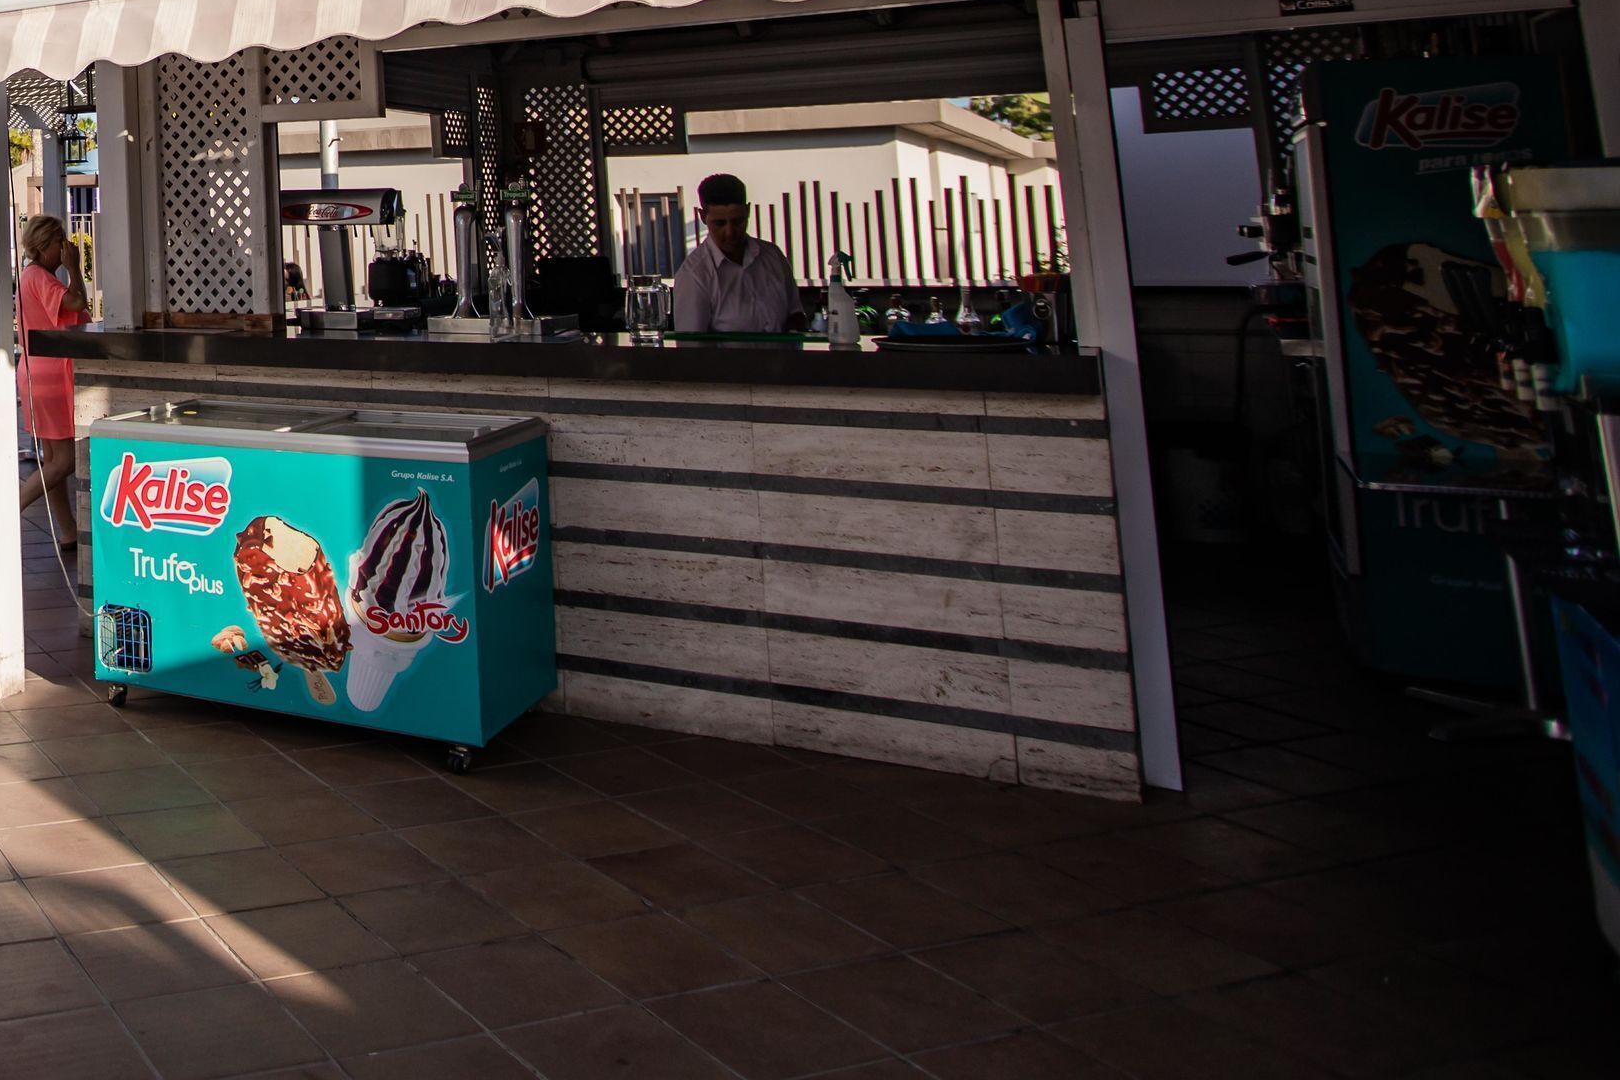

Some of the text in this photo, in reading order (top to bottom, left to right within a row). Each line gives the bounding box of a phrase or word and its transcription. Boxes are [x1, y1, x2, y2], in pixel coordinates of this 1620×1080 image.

[1370, 89, 1517, 149] Kalise
[111, 453, 230, 530] Kalise
[391, 470, 455, 482] Grupo Kalise S.A.
[129, 546, 197, 584] Trufo
[487, 500, 539, 591] Kalise
[189, 574, 224, 595] plus
